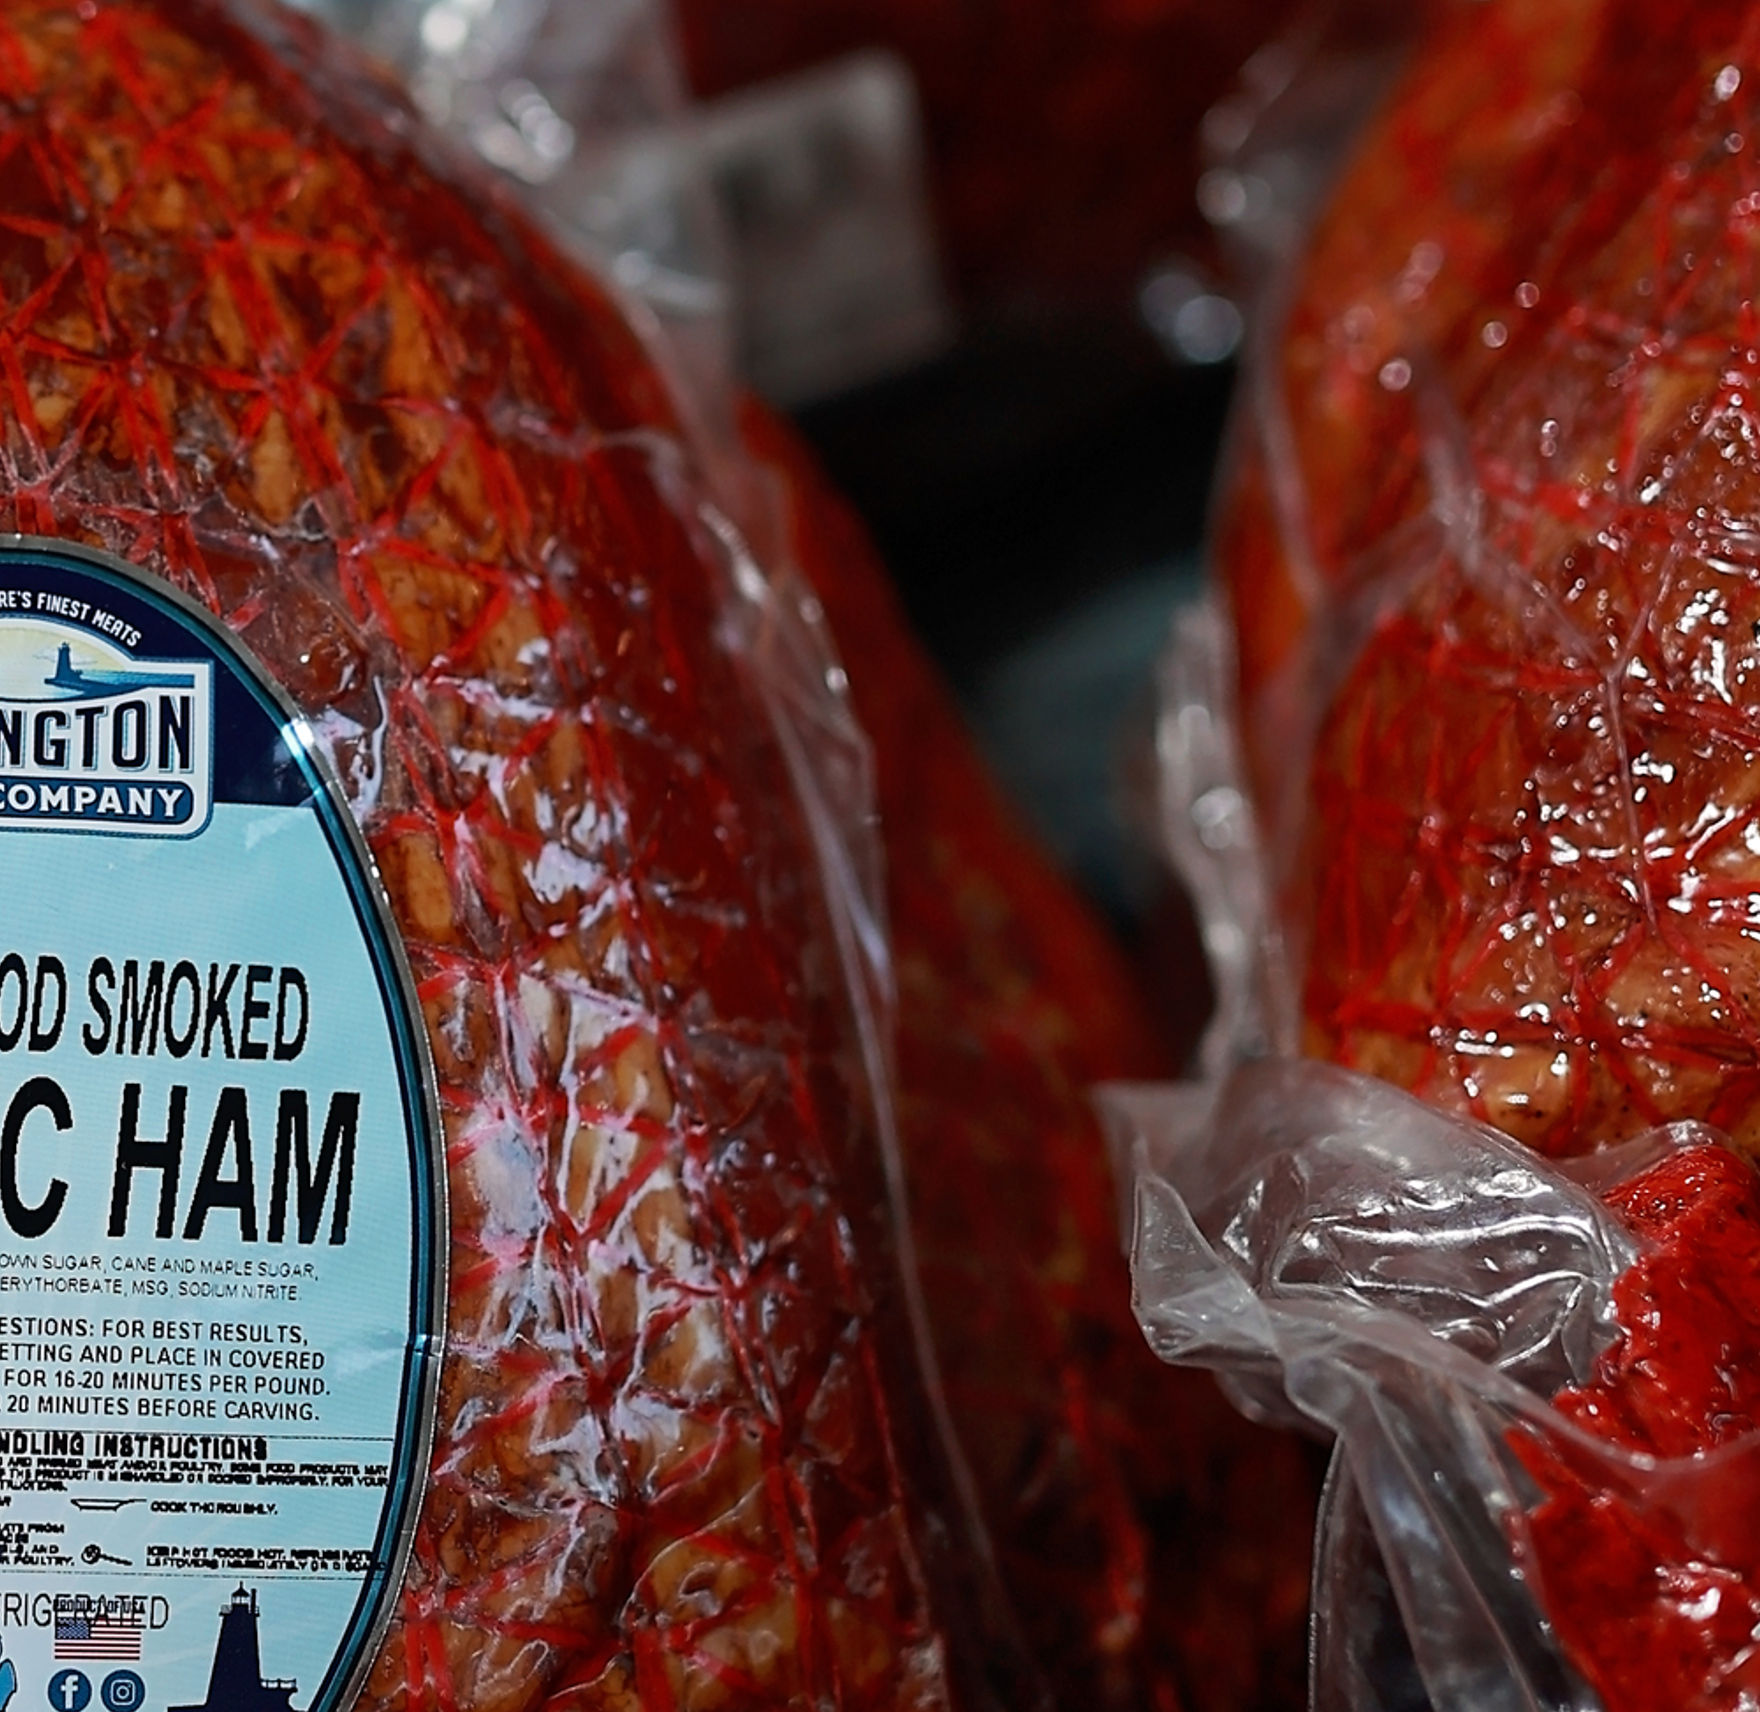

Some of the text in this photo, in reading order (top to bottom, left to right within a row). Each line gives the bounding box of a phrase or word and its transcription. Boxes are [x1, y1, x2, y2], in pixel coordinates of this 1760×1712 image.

[37, 592, 91, 620] FINEST
[91, 609, 142, 647] MEATS
[81, 957, 311, 1062] SMOKED
[106, 1082, 361, 1247] HAM
[42, 1255, 107, 1274] SUGAR,
[111, 1256, 156, 1272] CANE
[161, 1259, 196, 1274] AND
[200, 1260, 252, 1276] MAPLE
[257, 1262, 319, 1280] SUGAR,
[0, 1276, 128, 1296] ERYTHORBATE,
[132, 1280, 174, 1299] MSG,
[179, 1282, 239, 1298] SODIUM
[241, 1283, 302, 1301] NITRITE.
[102, 1319, 145, 1338] FOR
[153, 1320, 203, 1340] BEST
[209, 1322, 308, 1346] RESULTS,
[80, 1344, 123, 1364] AND
[130, 1346, 196, 1366] PLACE
[204, 1348, 222, 1366] IN
[229, 1350, 325, 1370] COVERED
[4, 1368, 47, 1387] FOR
[54, 1370, 104, 1389] 16-20
[112, 1372, 202, 1392] MINUTES
[210, 1375, 247, 1394] PER
[255, 1376, 331, 1396] POUND.
[7, 1394, 30, 1413] 20
[38, 1396, 129, 1416] MINUTES
[138, 1398, 216, 1418] BEFORE
[225, 1401, 320, 1421] CARVING.
[95, 1433, 267, 1460] INSTRUCTIONS
